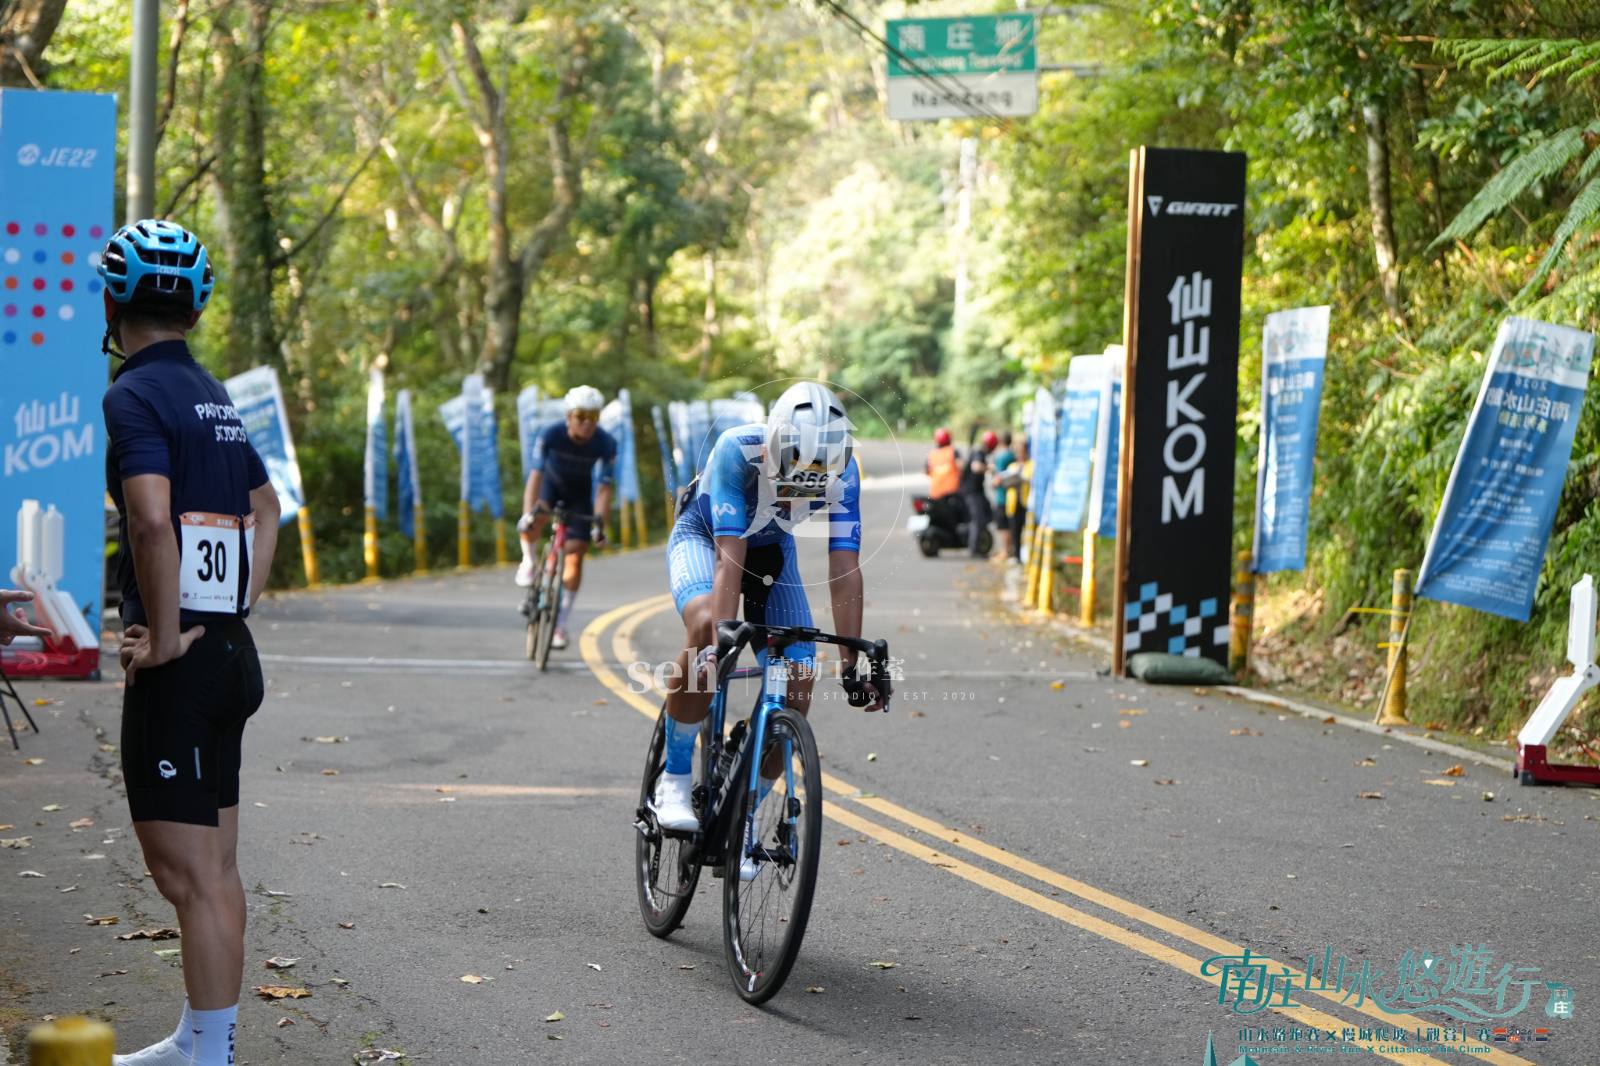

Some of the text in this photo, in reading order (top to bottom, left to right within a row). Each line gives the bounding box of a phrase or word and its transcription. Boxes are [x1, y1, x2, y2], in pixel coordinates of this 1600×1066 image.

[41, 147, 97, 168] JE22
[1166, 201, 1238, 217] GIANT
[14, 391, 79, 438] 仙山
[4, 422, 94, 476] KOM
[197, 539, 226, 583] 30
